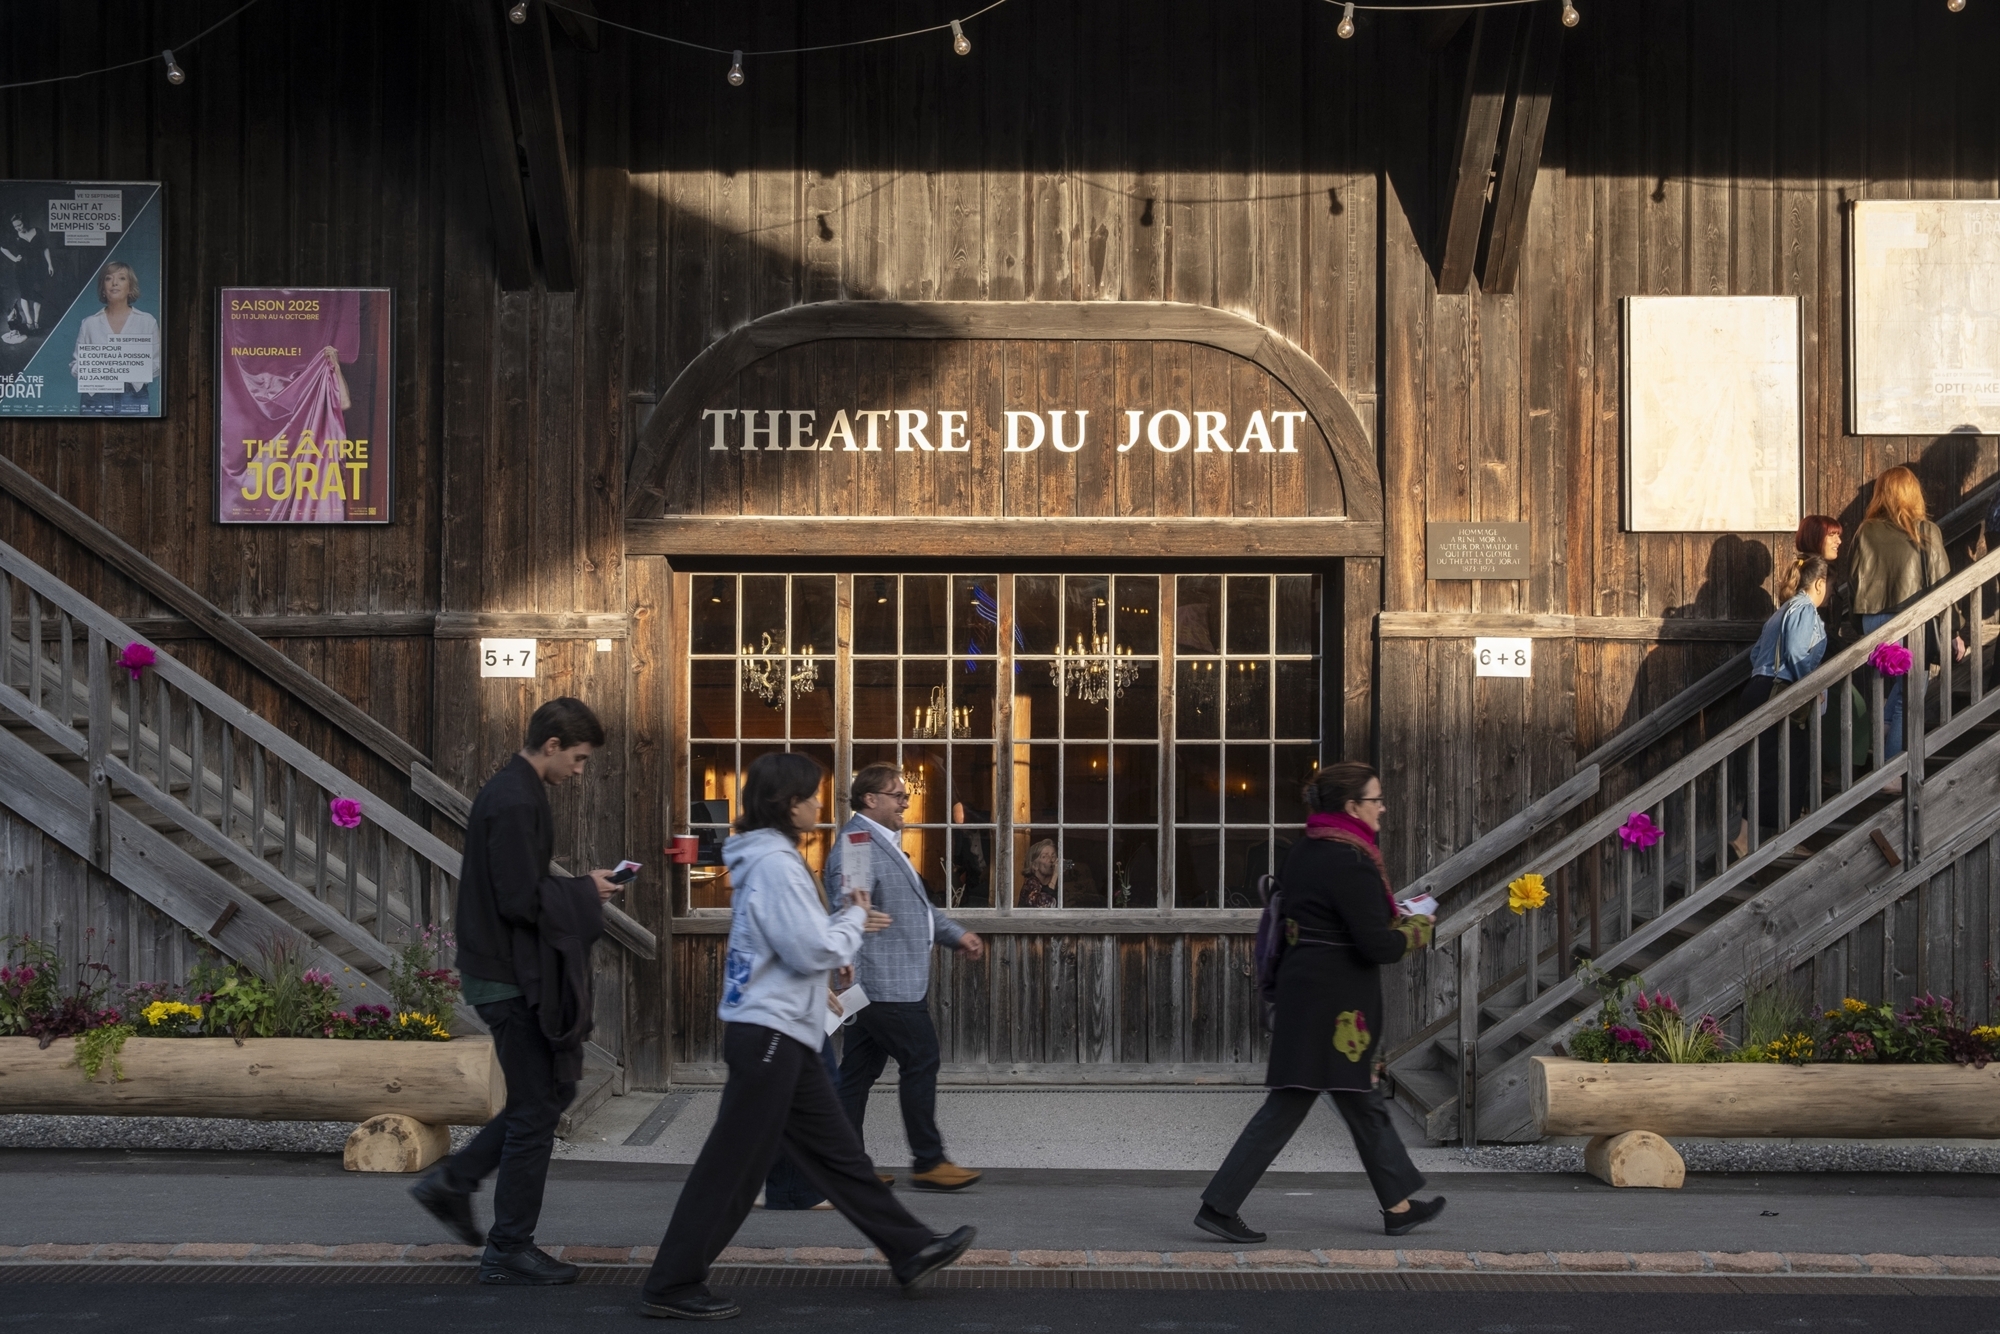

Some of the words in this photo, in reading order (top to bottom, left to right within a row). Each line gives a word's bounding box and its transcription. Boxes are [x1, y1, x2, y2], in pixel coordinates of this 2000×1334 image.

[231, 300, 285, 311] SAISON
[288, 300, 320, 311] 2025
[0, 372, 44, 383] HÉÂTRE
[701, 408, 971, 452] THEATRE
[1003, 409, 1089, 452] DU
[1116, 409, 1308, 454] JORAT
[243, 430, 368, 459] THÉÂTRE
[241, 461, 368, 500] JORAT
[485, 650, 497, 667] 5
[503, 654, 514, 666] +
[520, 650, 531, 666] 7
[1480, 649, 1491, 665] 6
[1497, 653, 1508, 665] +
[1514, 649, 1526, 666] 8
